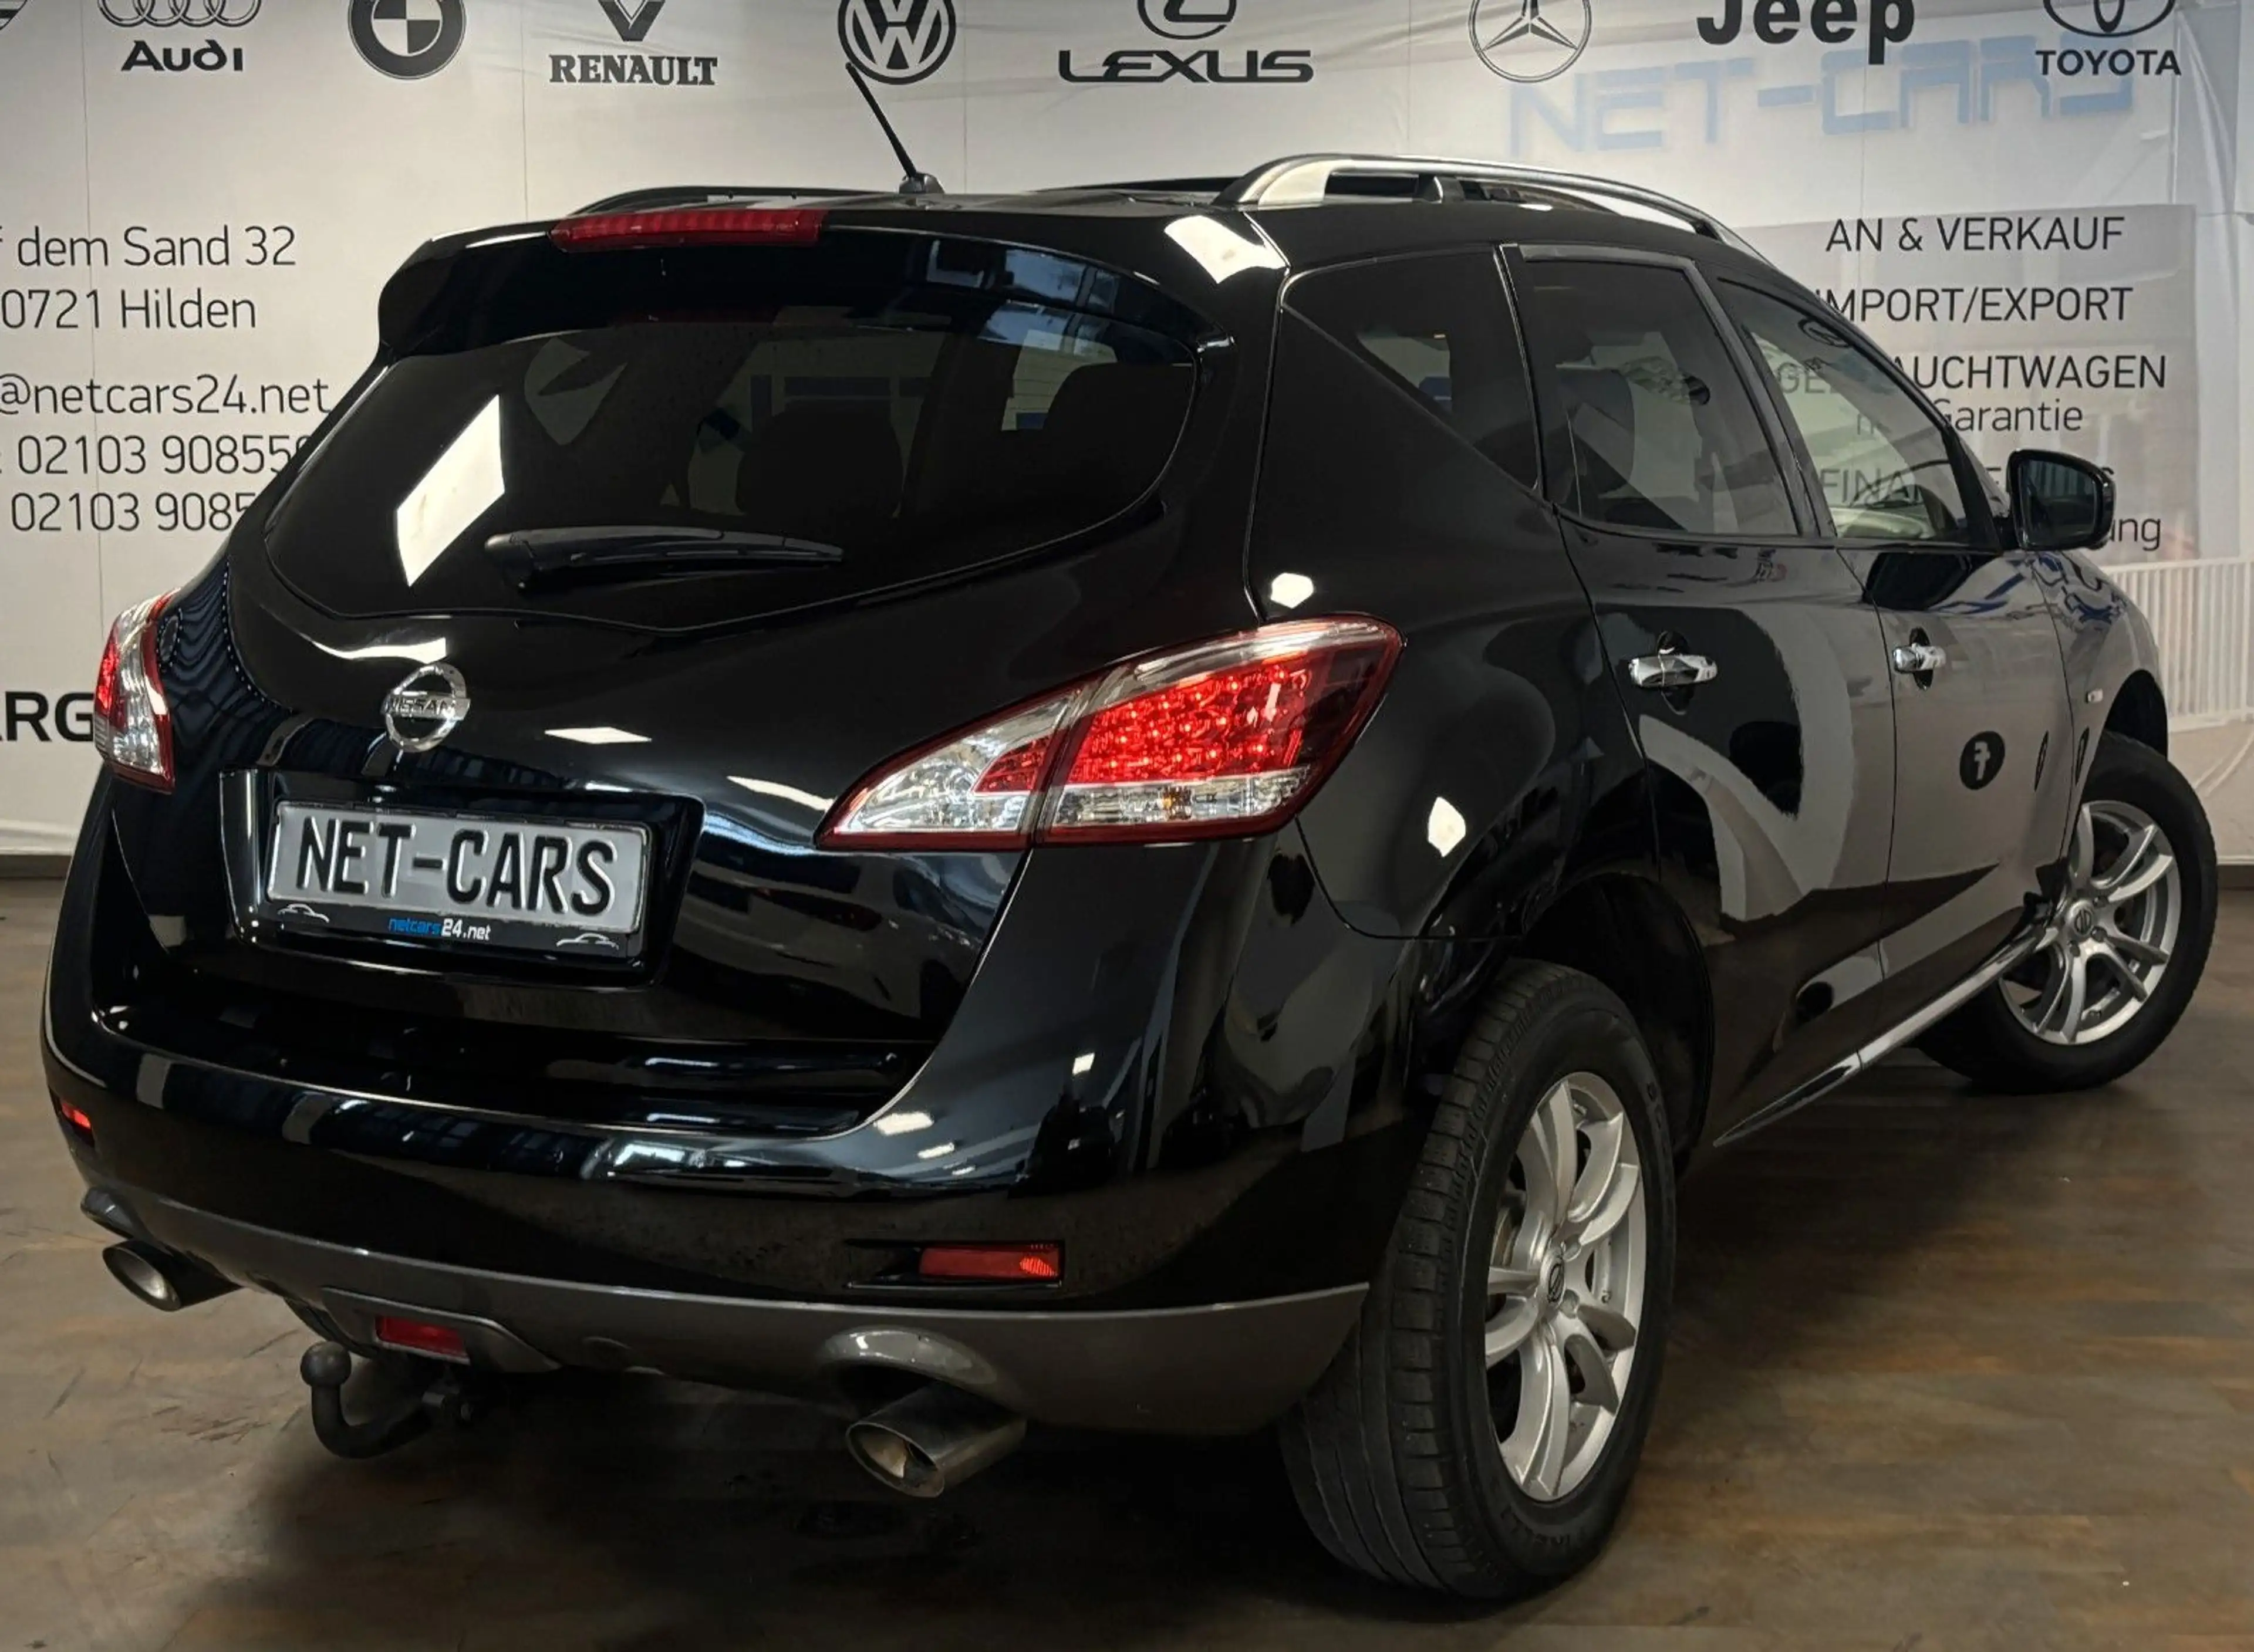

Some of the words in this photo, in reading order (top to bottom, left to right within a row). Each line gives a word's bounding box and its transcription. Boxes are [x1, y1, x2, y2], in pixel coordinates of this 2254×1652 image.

[1697, 0, 1915, 65] Jeep
[122, 40, 242, 71] Audi
[549, 55, 718, 86] RENAULT
[1058, 49, 1314, 83] LEXUS
[2034, 49, 2182, 76] TOYOTA
[18, 225, 108, 266] dem
[124, 225, 229, 266] Sand
[245, 226, 295, 265] 32
[1826, 218, 1882, 252] AN
[1898, 217, 1922, 251] &
[1936, 216, 2125, 251] VERKAUF
[121, 288, 256, 328] Hilden
[1816, 286, 2134, 323] MPORT/EXPORT
[18, 435, 146, 474] 02103
[11, 492, 139, 531] 02103
[0, 691, 94, 742] RG
[296, 816, 618, 915] NET-CARS
[388, 915, 491, 942] netcars24.net
